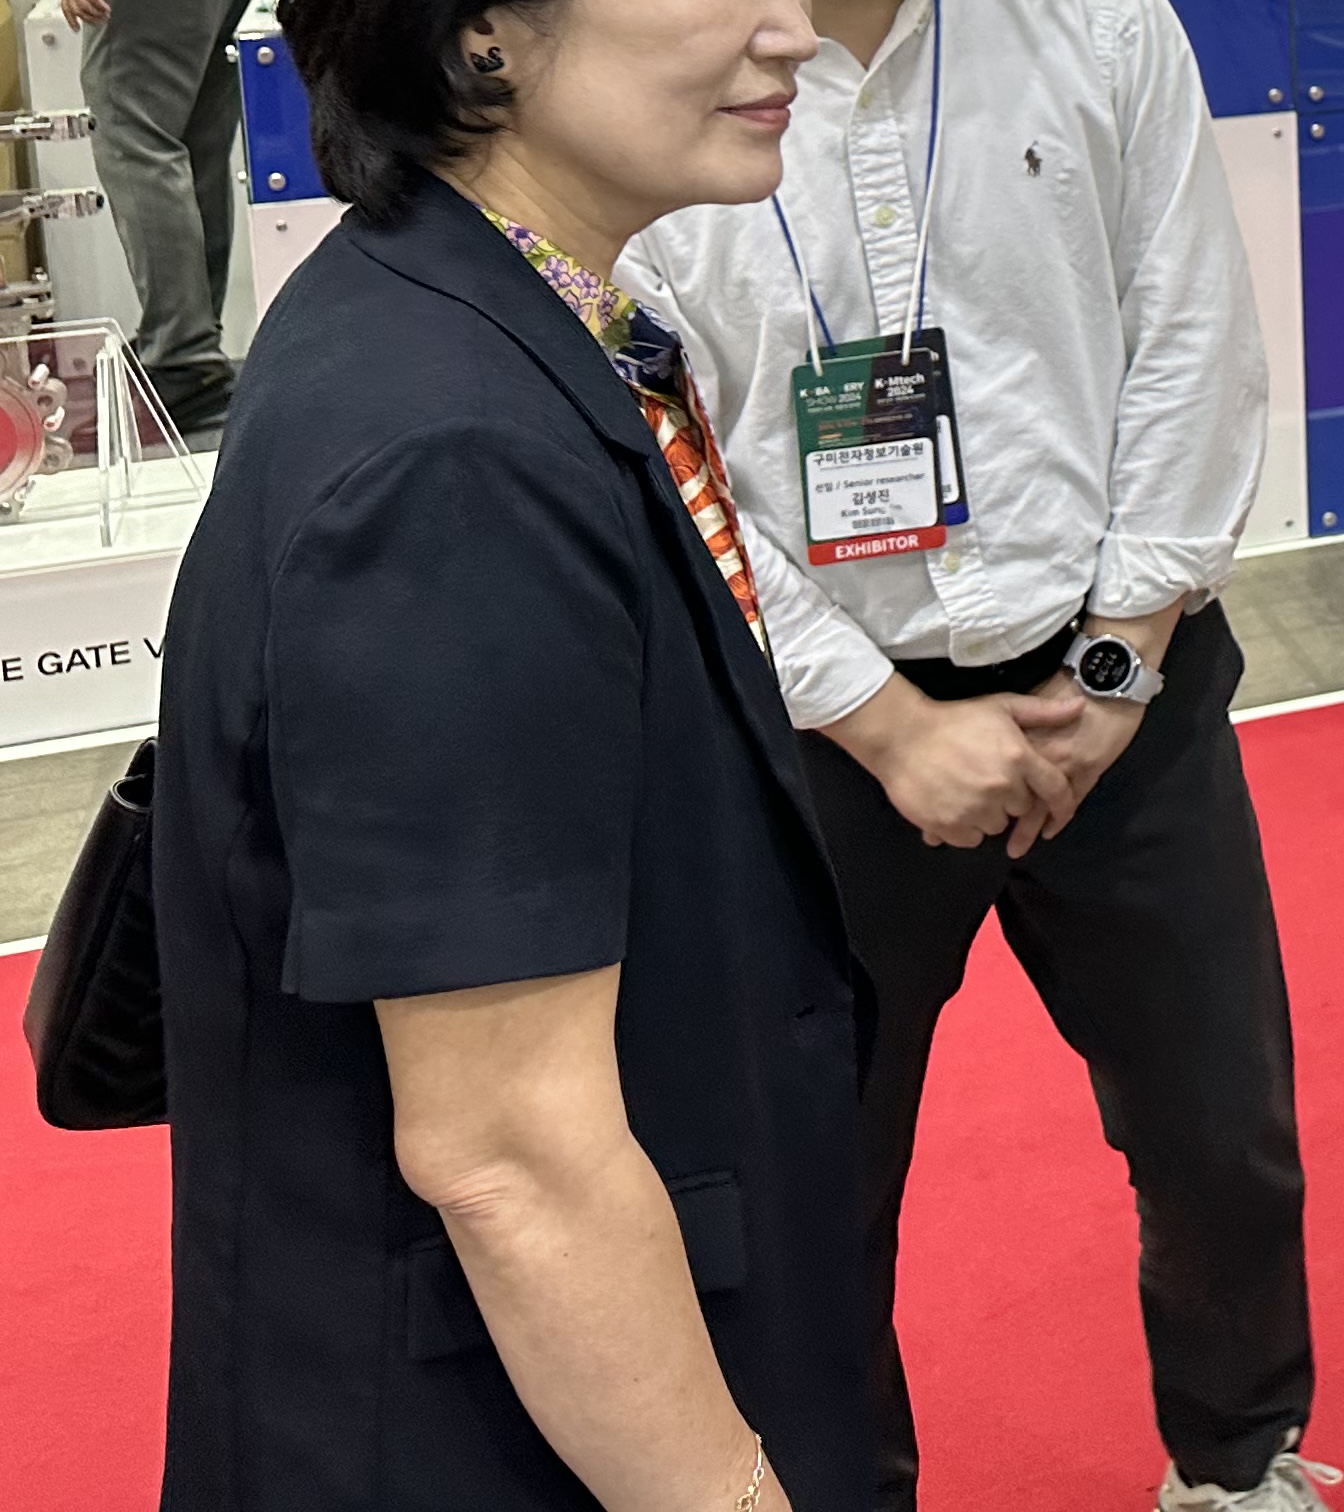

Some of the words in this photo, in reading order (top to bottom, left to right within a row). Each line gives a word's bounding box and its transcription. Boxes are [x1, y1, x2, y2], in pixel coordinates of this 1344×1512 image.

[843, 477, 874, 489] Senior
[876, 472, 925, 486] researcher
[835, 534, 919, 560] EXHIBITOR
[37, 640, 131, 676] GATE
